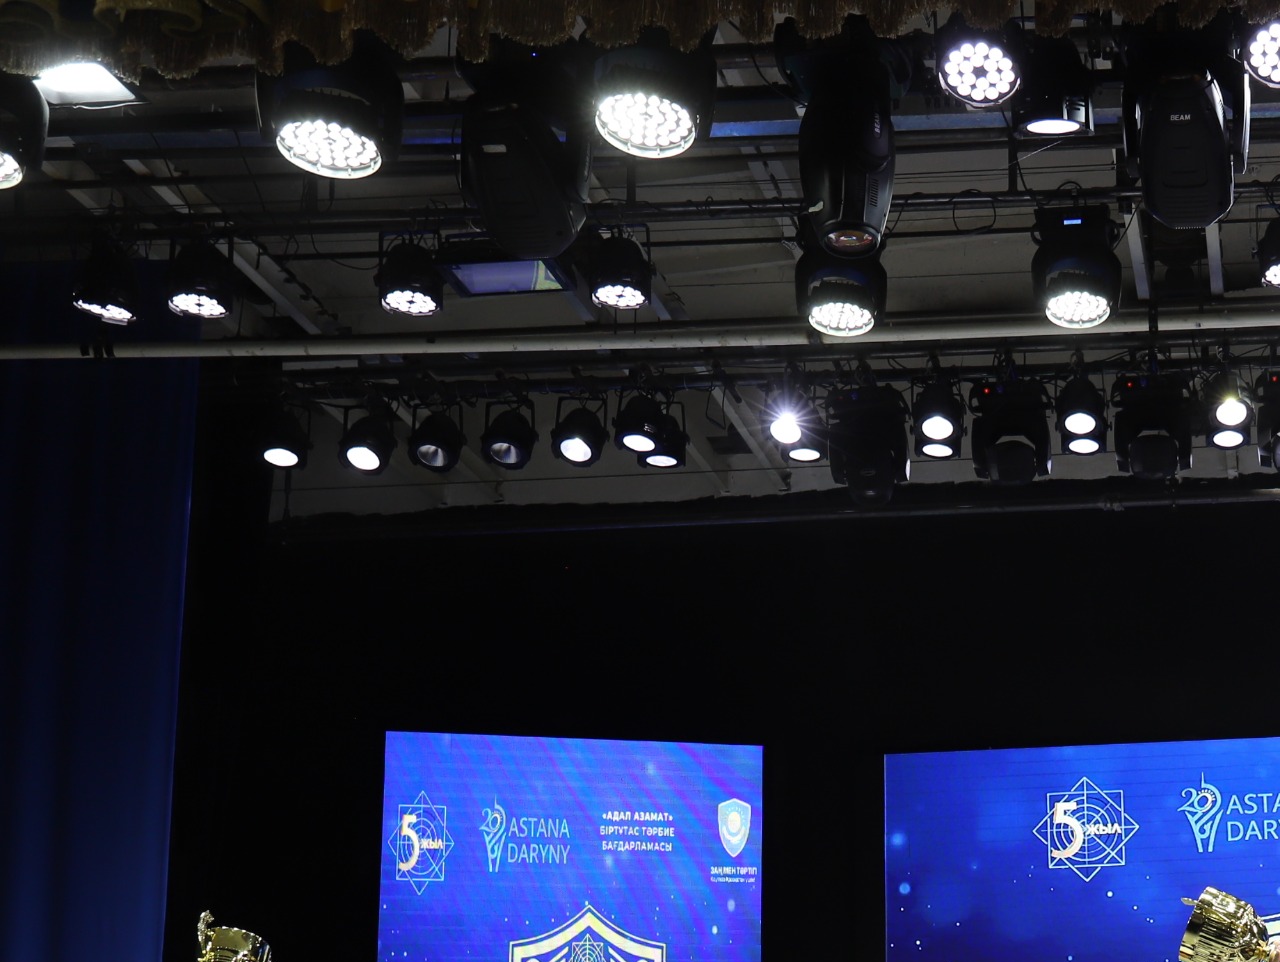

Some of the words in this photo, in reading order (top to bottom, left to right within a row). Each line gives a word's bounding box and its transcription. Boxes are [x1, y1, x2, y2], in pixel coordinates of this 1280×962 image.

[398, 814, 419, 871] 5
[508, 816, 570, 839] ASTANA
[1051, 801, 1084, 858] 5
[1084, 824, 1122, 836] ЖЫЛ
[507, 843, 570, 865] DARYNY
